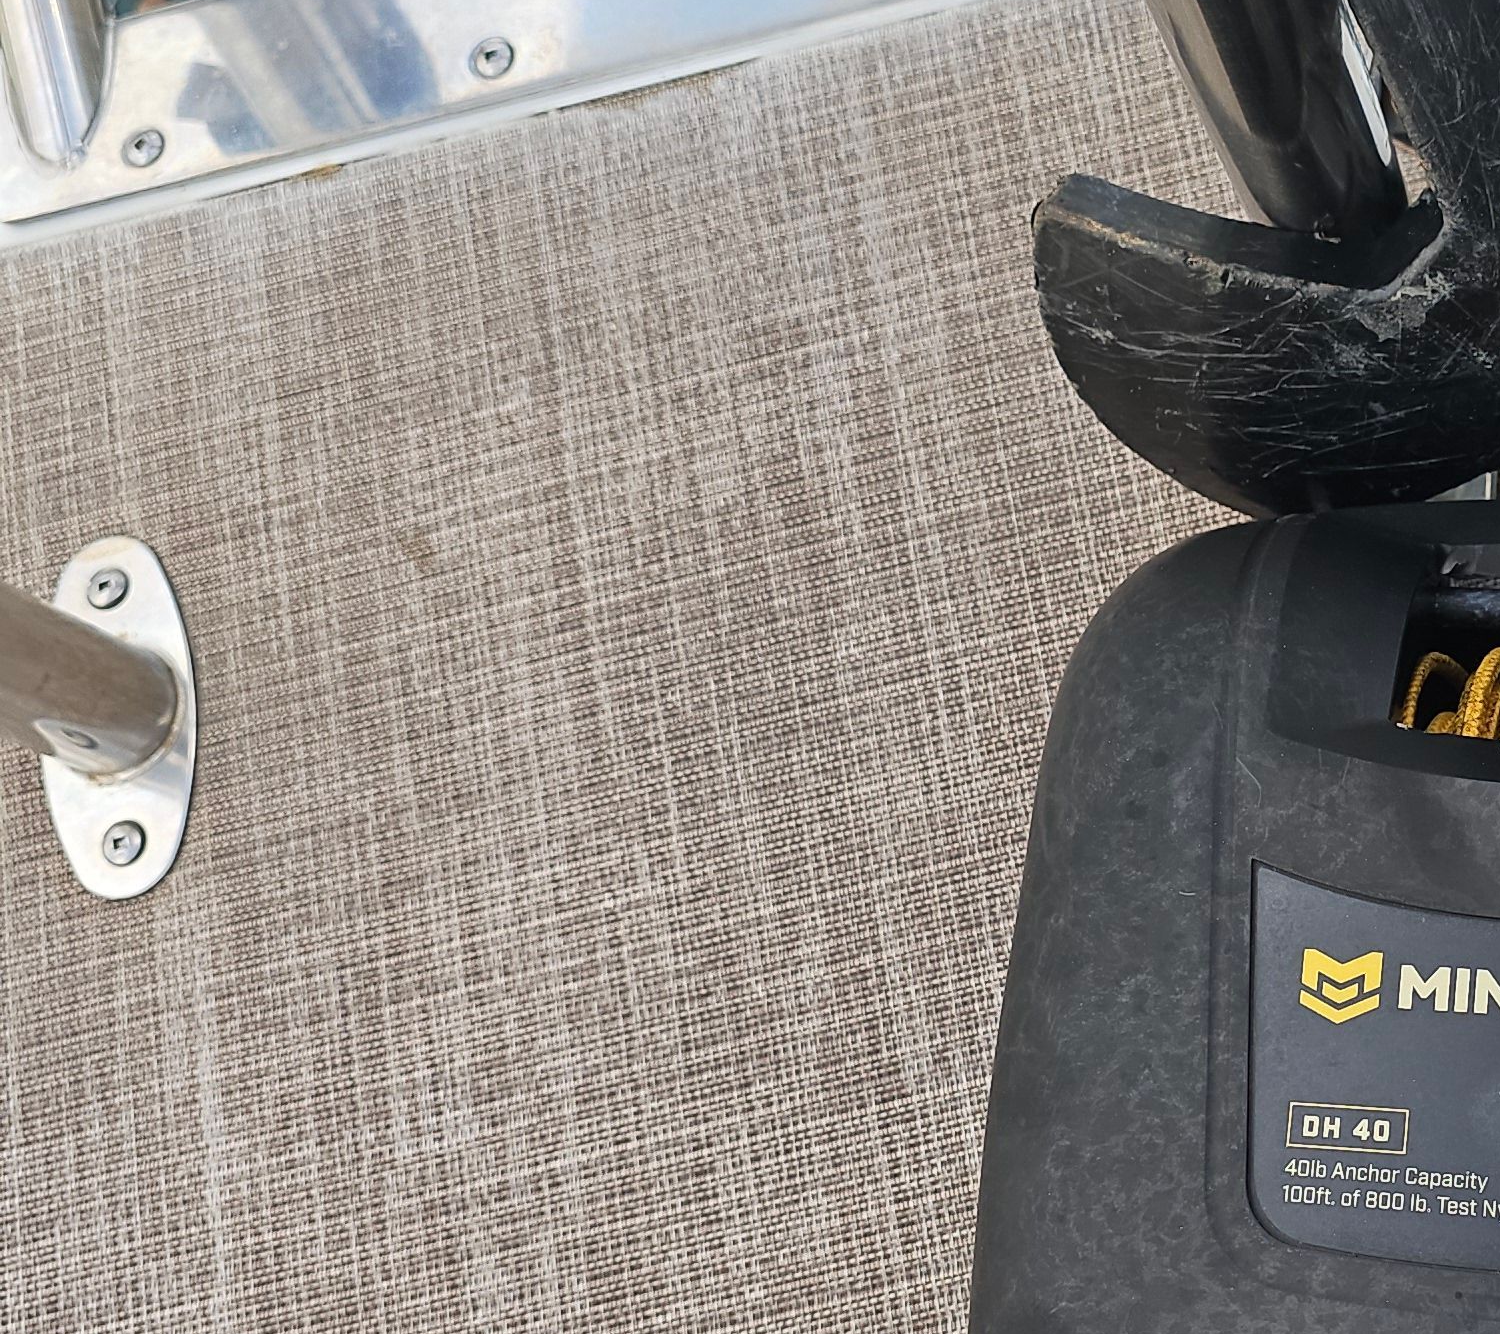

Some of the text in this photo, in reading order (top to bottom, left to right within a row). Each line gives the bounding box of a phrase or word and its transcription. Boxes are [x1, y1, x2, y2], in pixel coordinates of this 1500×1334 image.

[1302, 1114, 1390, 1142] DH 40
[1284, 1158, 1489, 1194] 40lb Anchor Capacity
[1282, 1184, 1336, 1207] 100ft.
[1340, 1189, 1362, 1208] of
[1365, 1190, 1405, 1211] 800
[1410, 1193, 1432, 1214] lb.
[1436, 1195, 1478, 1217] Test
